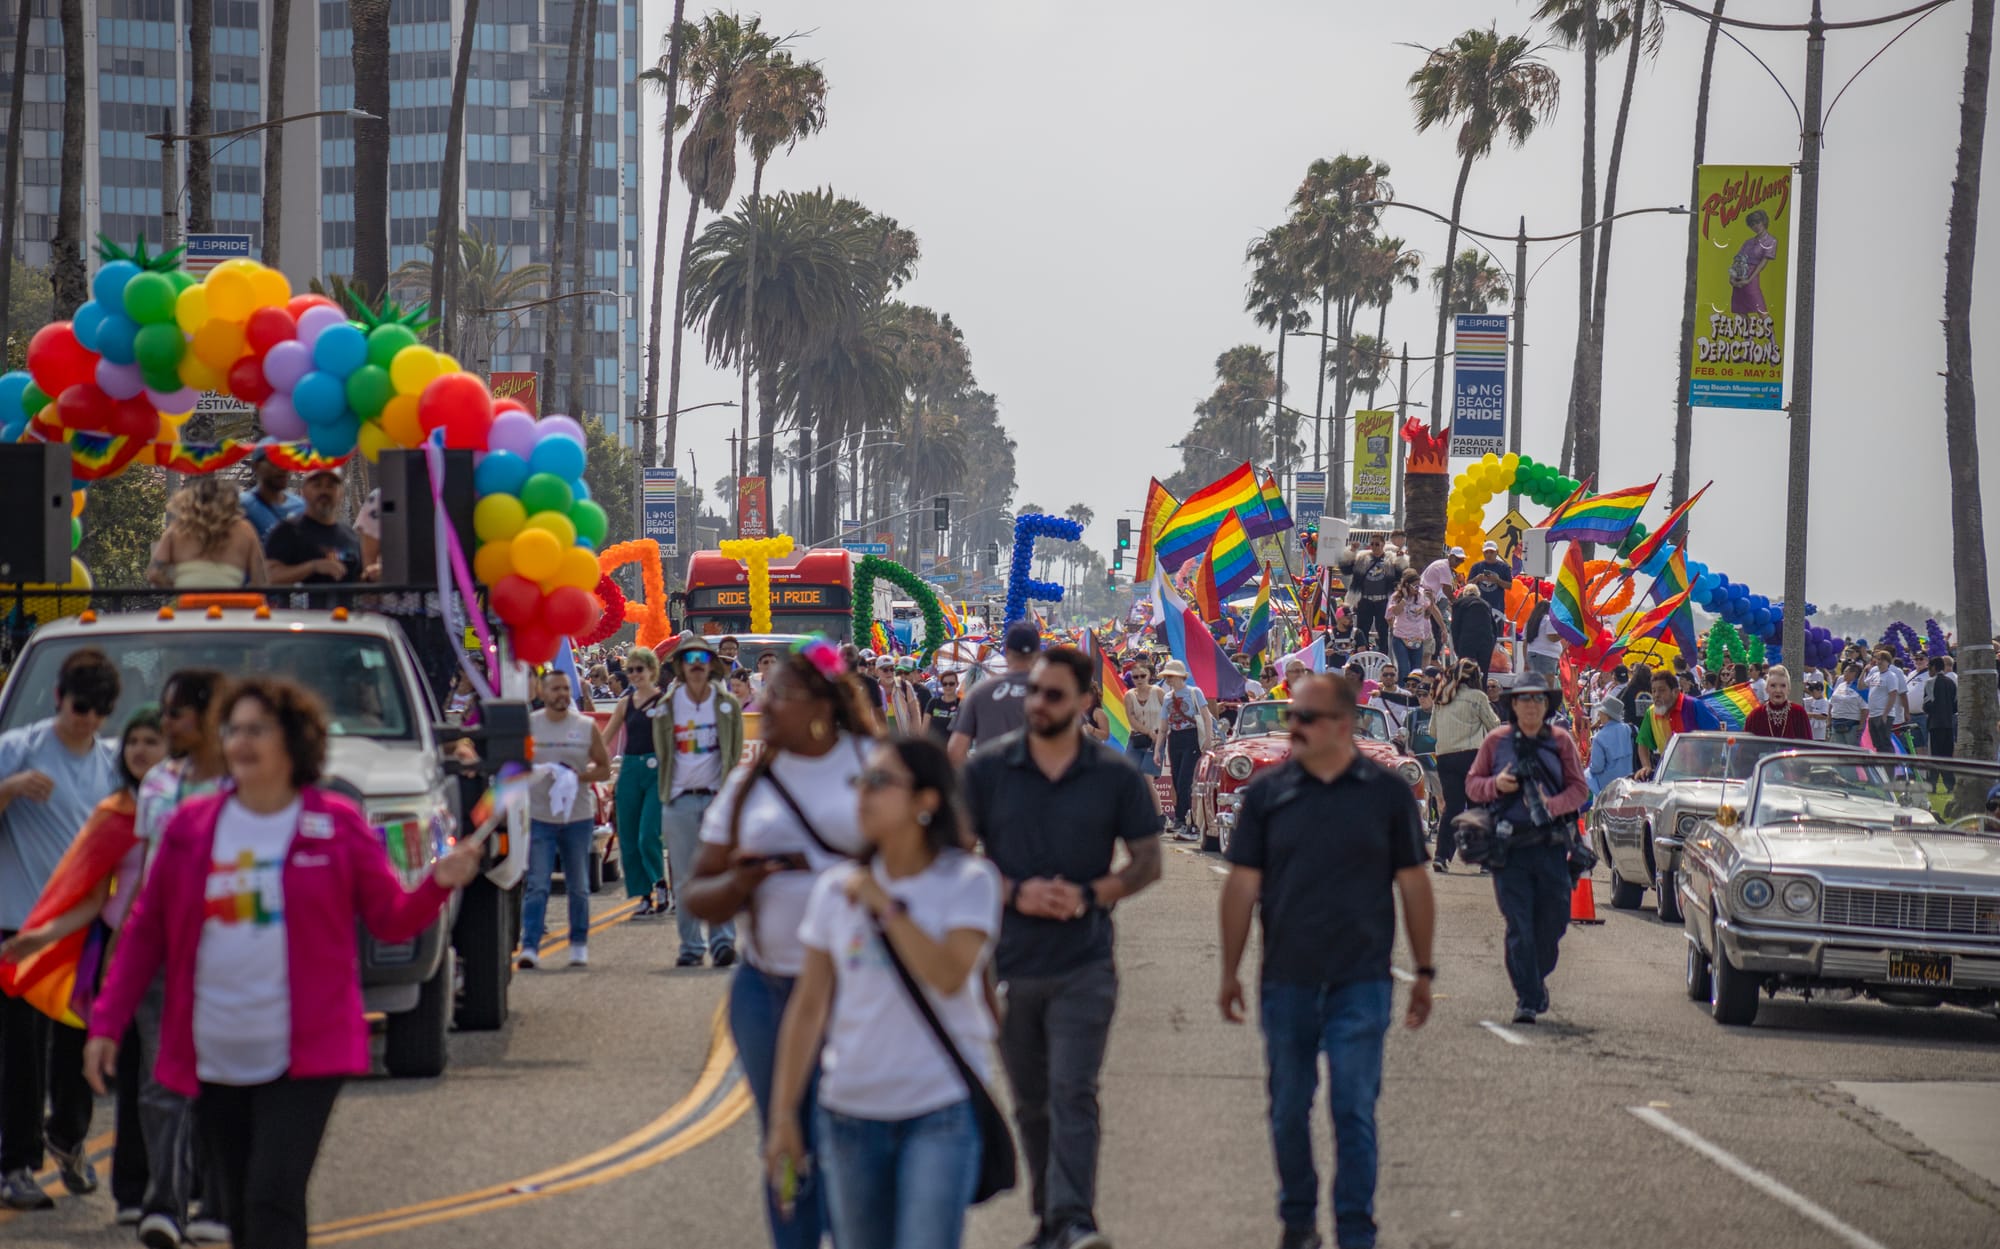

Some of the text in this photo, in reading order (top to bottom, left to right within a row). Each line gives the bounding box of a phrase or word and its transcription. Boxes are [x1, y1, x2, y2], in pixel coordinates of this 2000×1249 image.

[189, 240, 248, 250] #LBPRIDE
[1458, 319, 1505, 328] #LBPRIDE
[1710, 313, 1774, 339] FEARLESS
[1697, 336, 1781, 365] DEPICTIONS
[1695, 367, 1718, 376] FEB.
[1721, 368, 1734, 377] 06
[1744, 369, 1767, 378] MAY
[1769, 370, 1781, 378] 31
[1694, 383, 1710, 392] Long
[1711, 384, 1732, 392] Beach
[196, 400, 249, 410] ESTIVAL
[1457, 397, 1502, 408] BEACH
[1457, 409, 1502, 420] PRIDE
[1453, 438, 1503, 447] PARADE &
[1453, 446, 1502, 456] FESTIVAL
[646, 519, 675, 527] BEACH
[646, 527, 675, 535] PRIDE
[718, 592, 745, 604] RIDE
[784, 591, 821, 603] PRIDE
